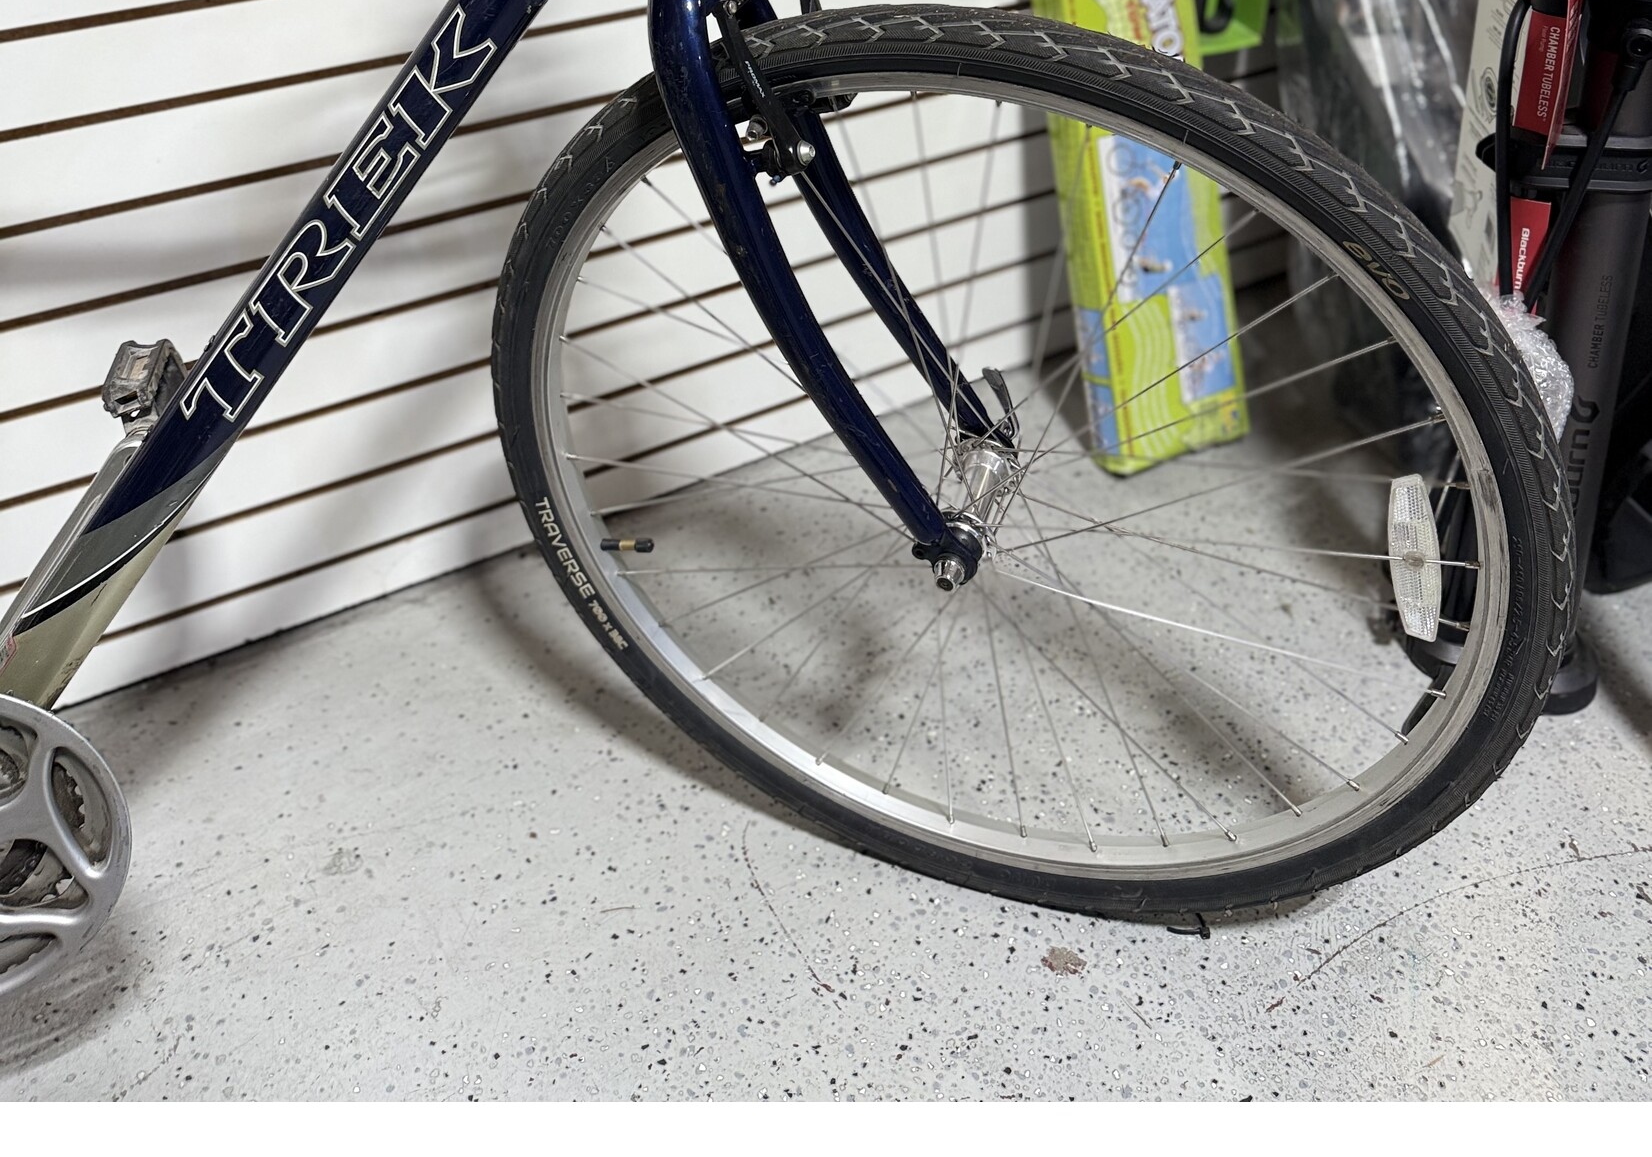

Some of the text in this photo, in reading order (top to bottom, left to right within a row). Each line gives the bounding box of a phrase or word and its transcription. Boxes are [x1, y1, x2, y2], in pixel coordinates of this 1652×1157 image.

[1536, 26, 1561, 118] CHAMBER TUBELESS
[180, 4, 498, 424] TREK
[1342, 240, 1410, 300] evo
[1513, 227, 1531, 291] Blackburn
[1587, 323, 1605, 370] CHAMBER
[535, 496, 596, 599] TRAVERSE
